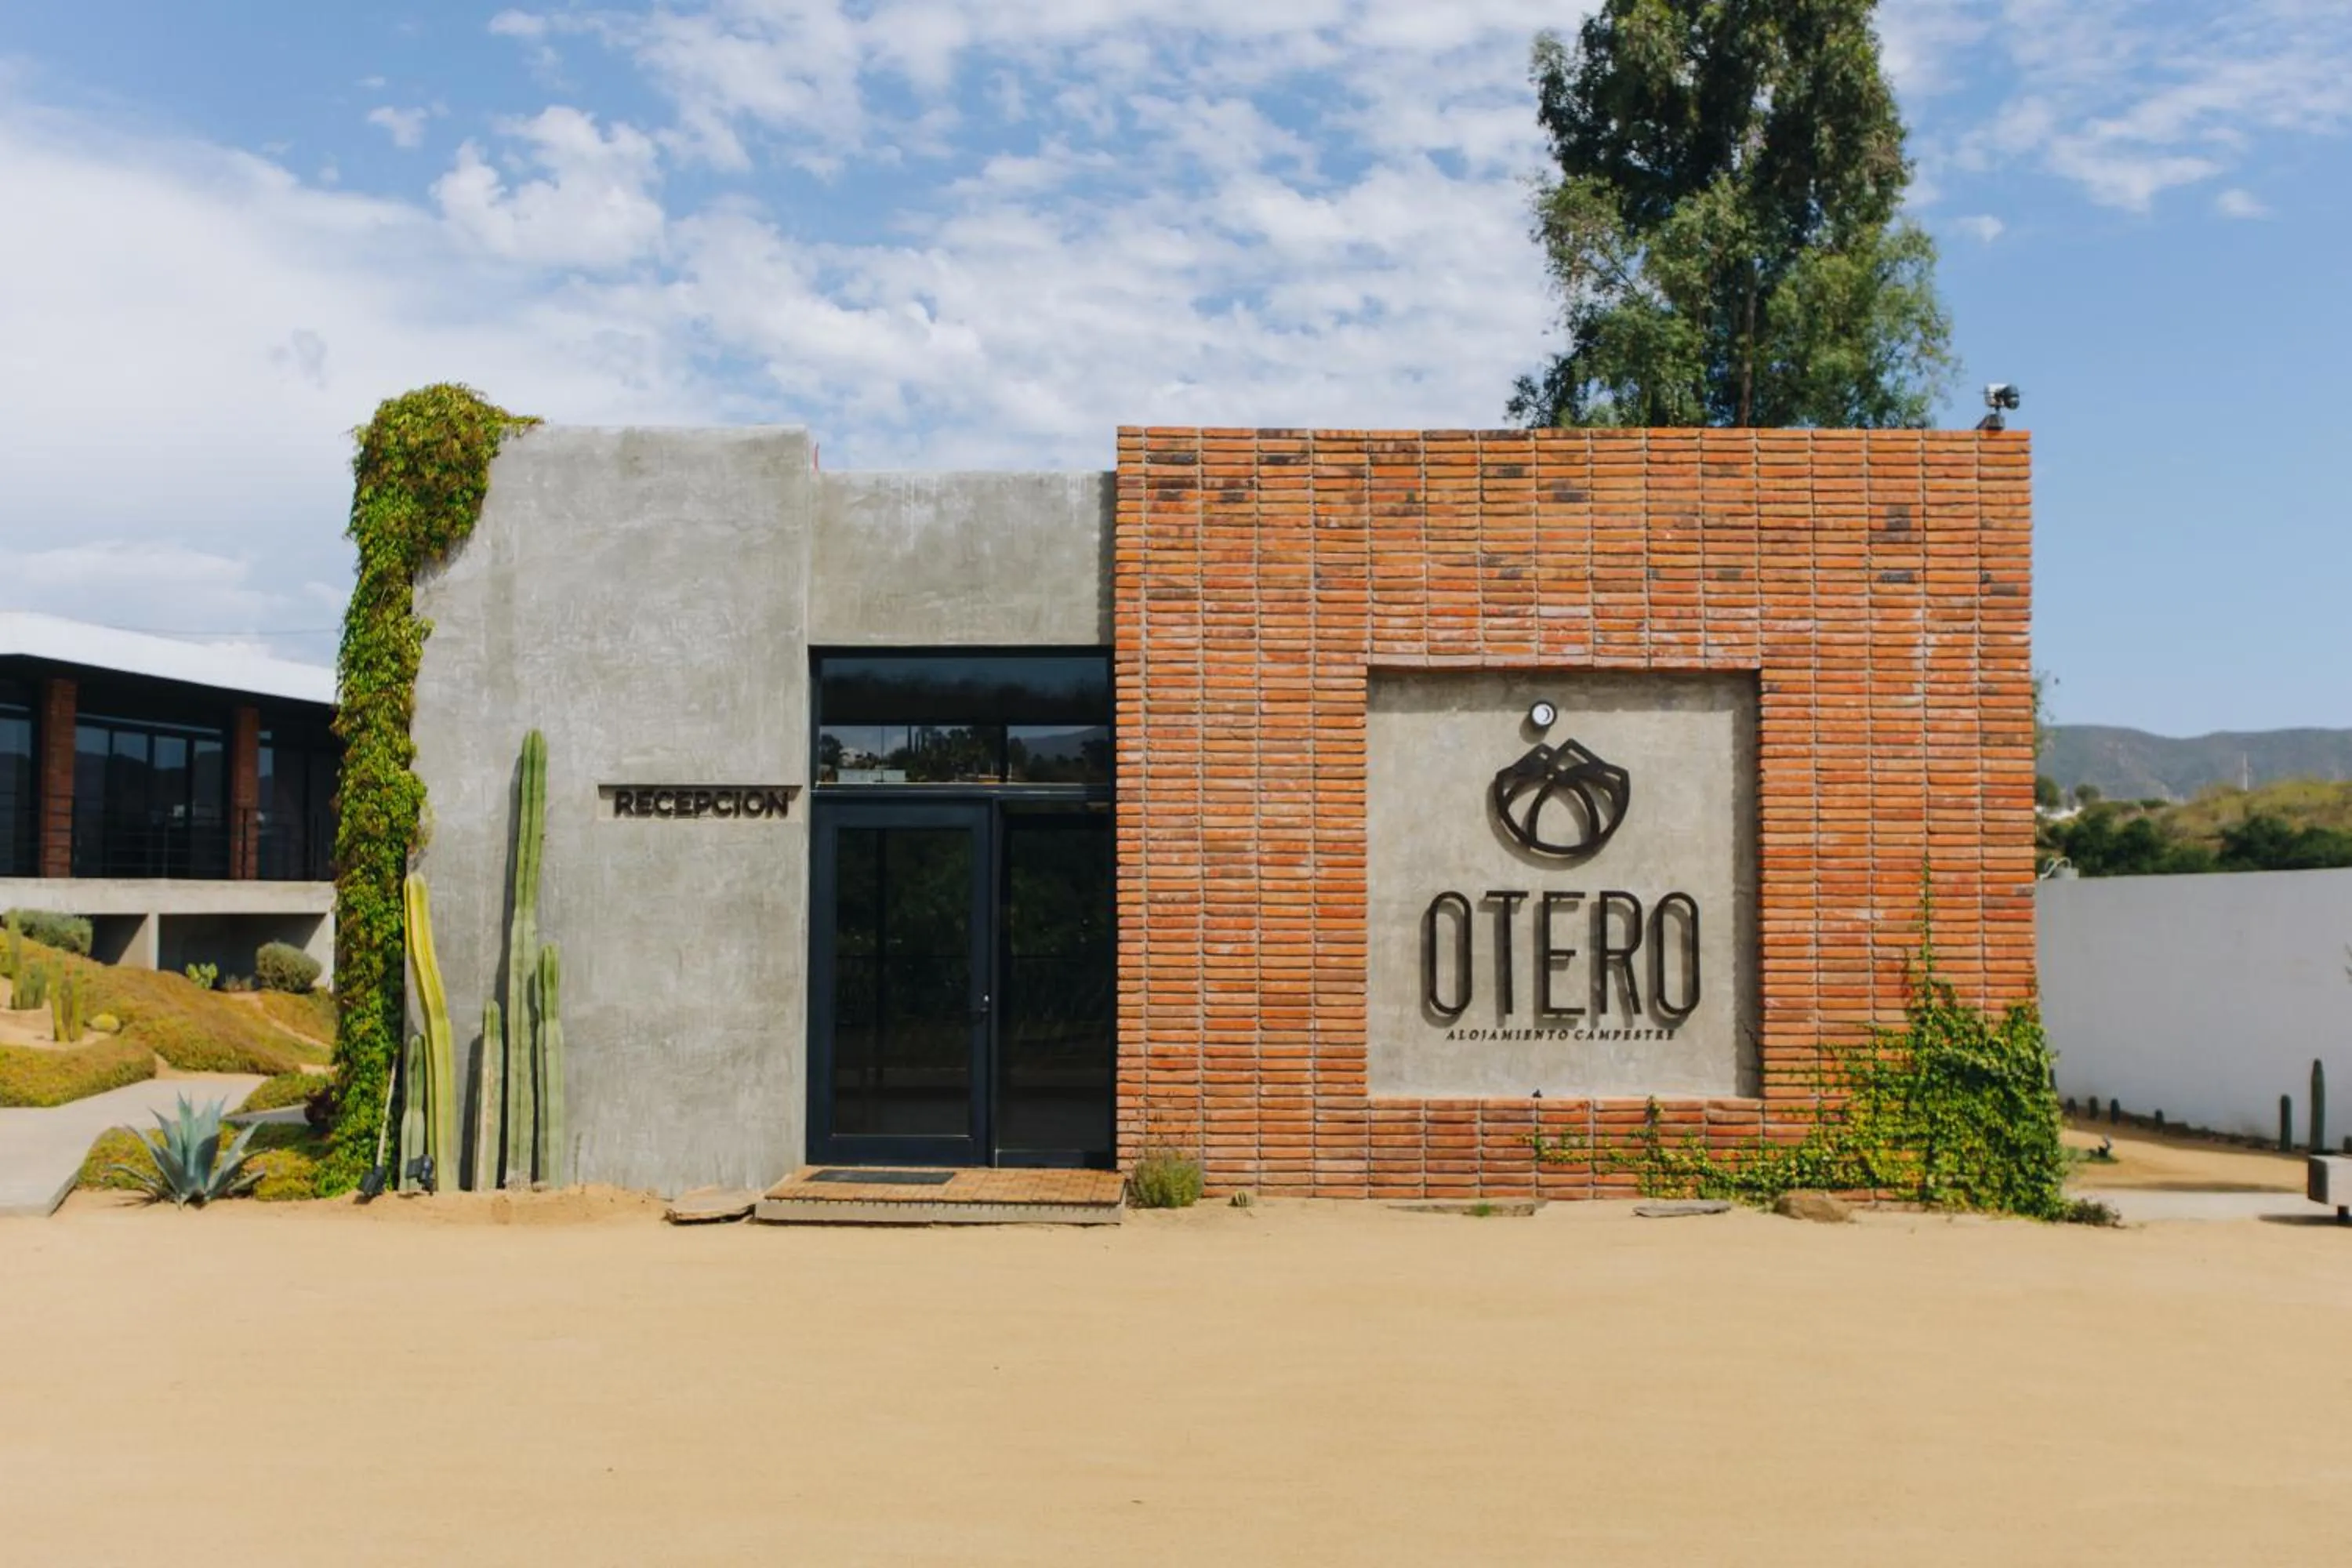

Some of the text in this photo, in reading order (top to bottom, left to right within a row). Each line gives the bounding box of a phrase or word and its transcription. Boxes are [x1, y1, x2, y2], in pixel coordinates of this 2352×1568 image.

[614, 789, 789, 818] RECEPCION
[1429, 890, 1700, 1014] OTERO
[1446, 1029, 1675, 1041] ALOJAMIENTO CAMPESTRE
